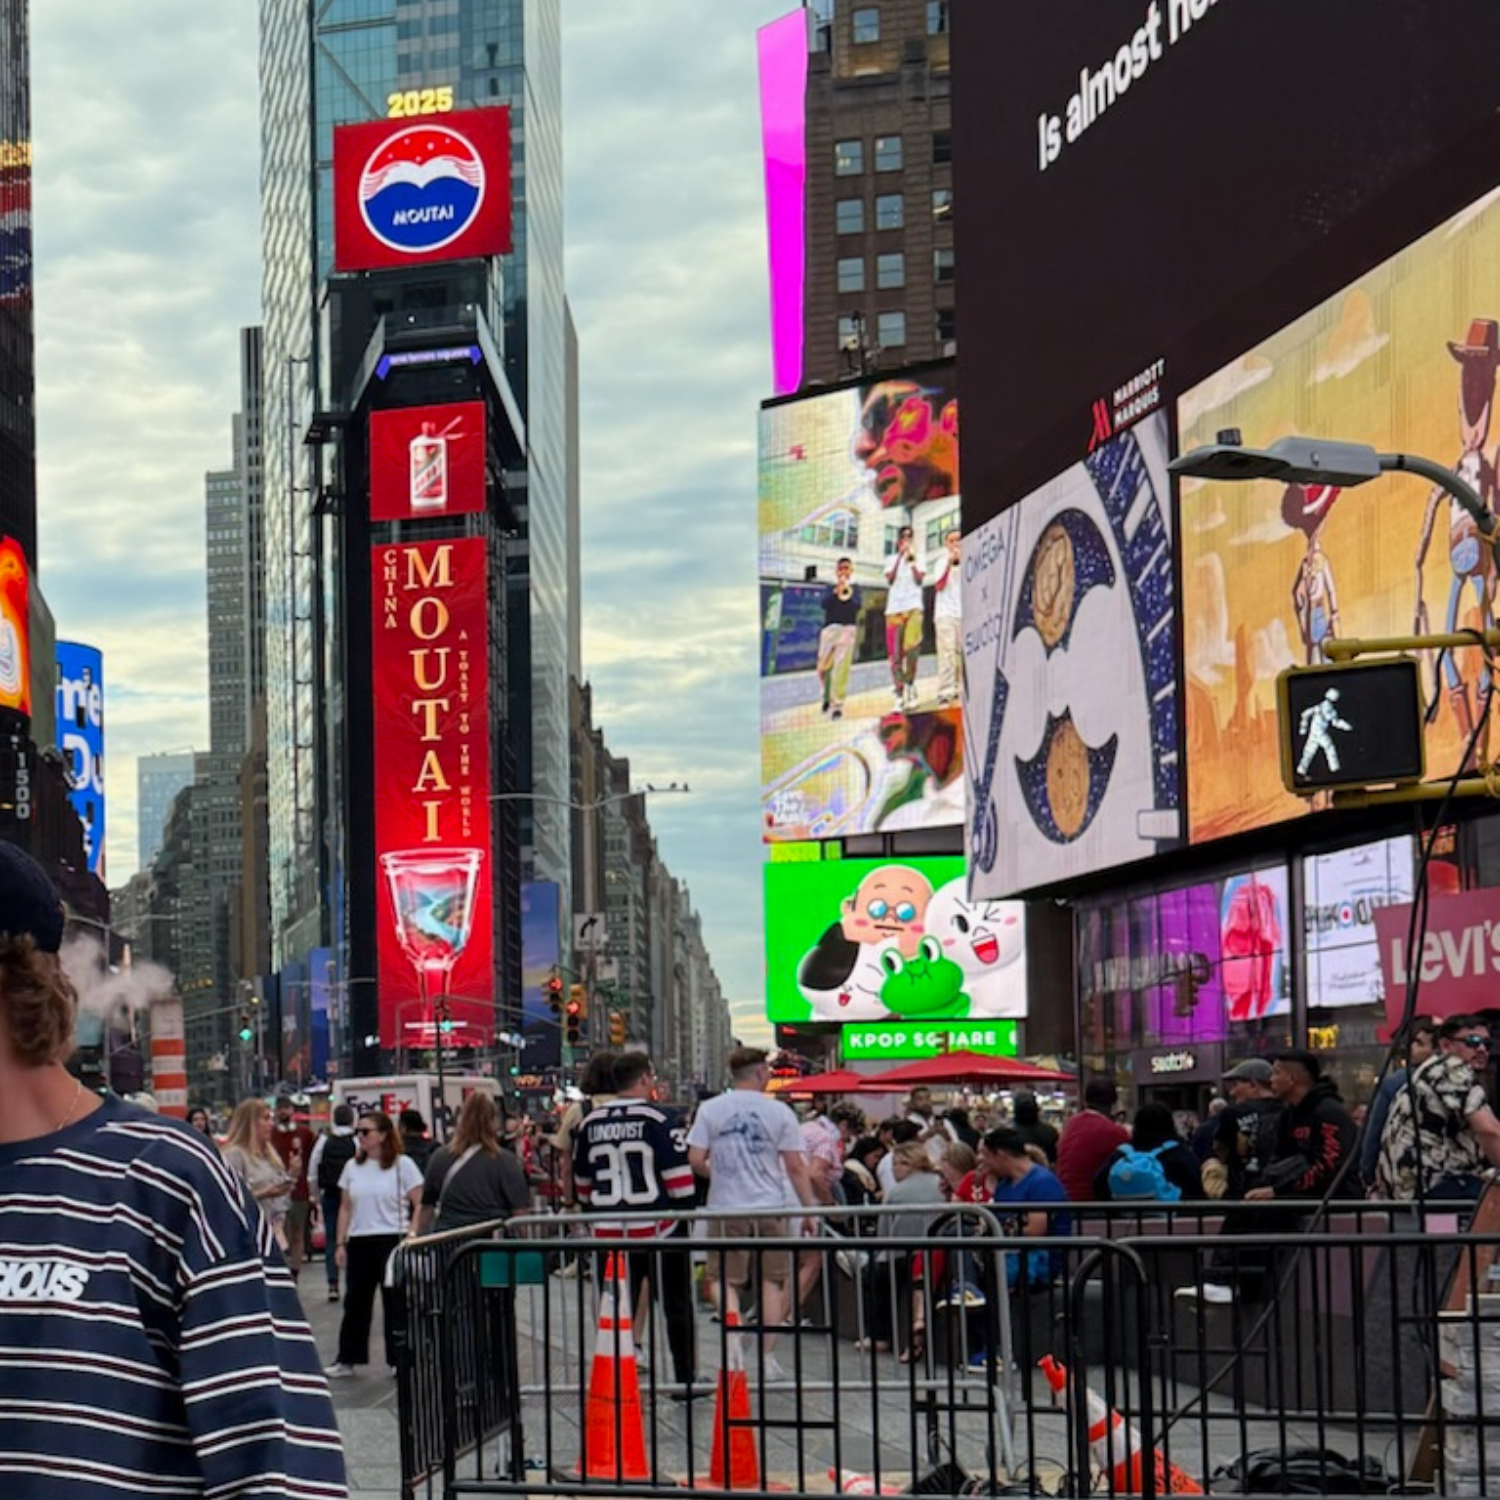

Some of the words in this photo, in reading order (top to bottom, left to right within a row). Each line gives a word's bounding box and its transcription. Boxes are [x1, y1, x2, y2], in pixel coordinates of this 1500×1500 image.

[387, 86, 454, 118] 2025
[1038, 112, 1061, 171] Is
[1065, 1, 1162, 144] almost
[392, 204, 454, 226] MOUTAI
[1113, 357, 1164, 407] MARRIOTT
[1113, 384, 1159, 428] MARQUIS
[965, 527, 1005, 583] OMEGA
[383, 549, 398, 629] CHINA
[403, 544, 455, 843] MOUTAI
[459, 712, 470, 734] TO
[460, 743, 470, 776] THE
[15, 751, 31, 819] 1500
[850, 1031, 907, 1049] KPOP
[347, 1093, 412, 1115] FedEx
[587, 1121, 646, 1143] LUNDQVIST
[588, 1140, 660, 1206] 30
